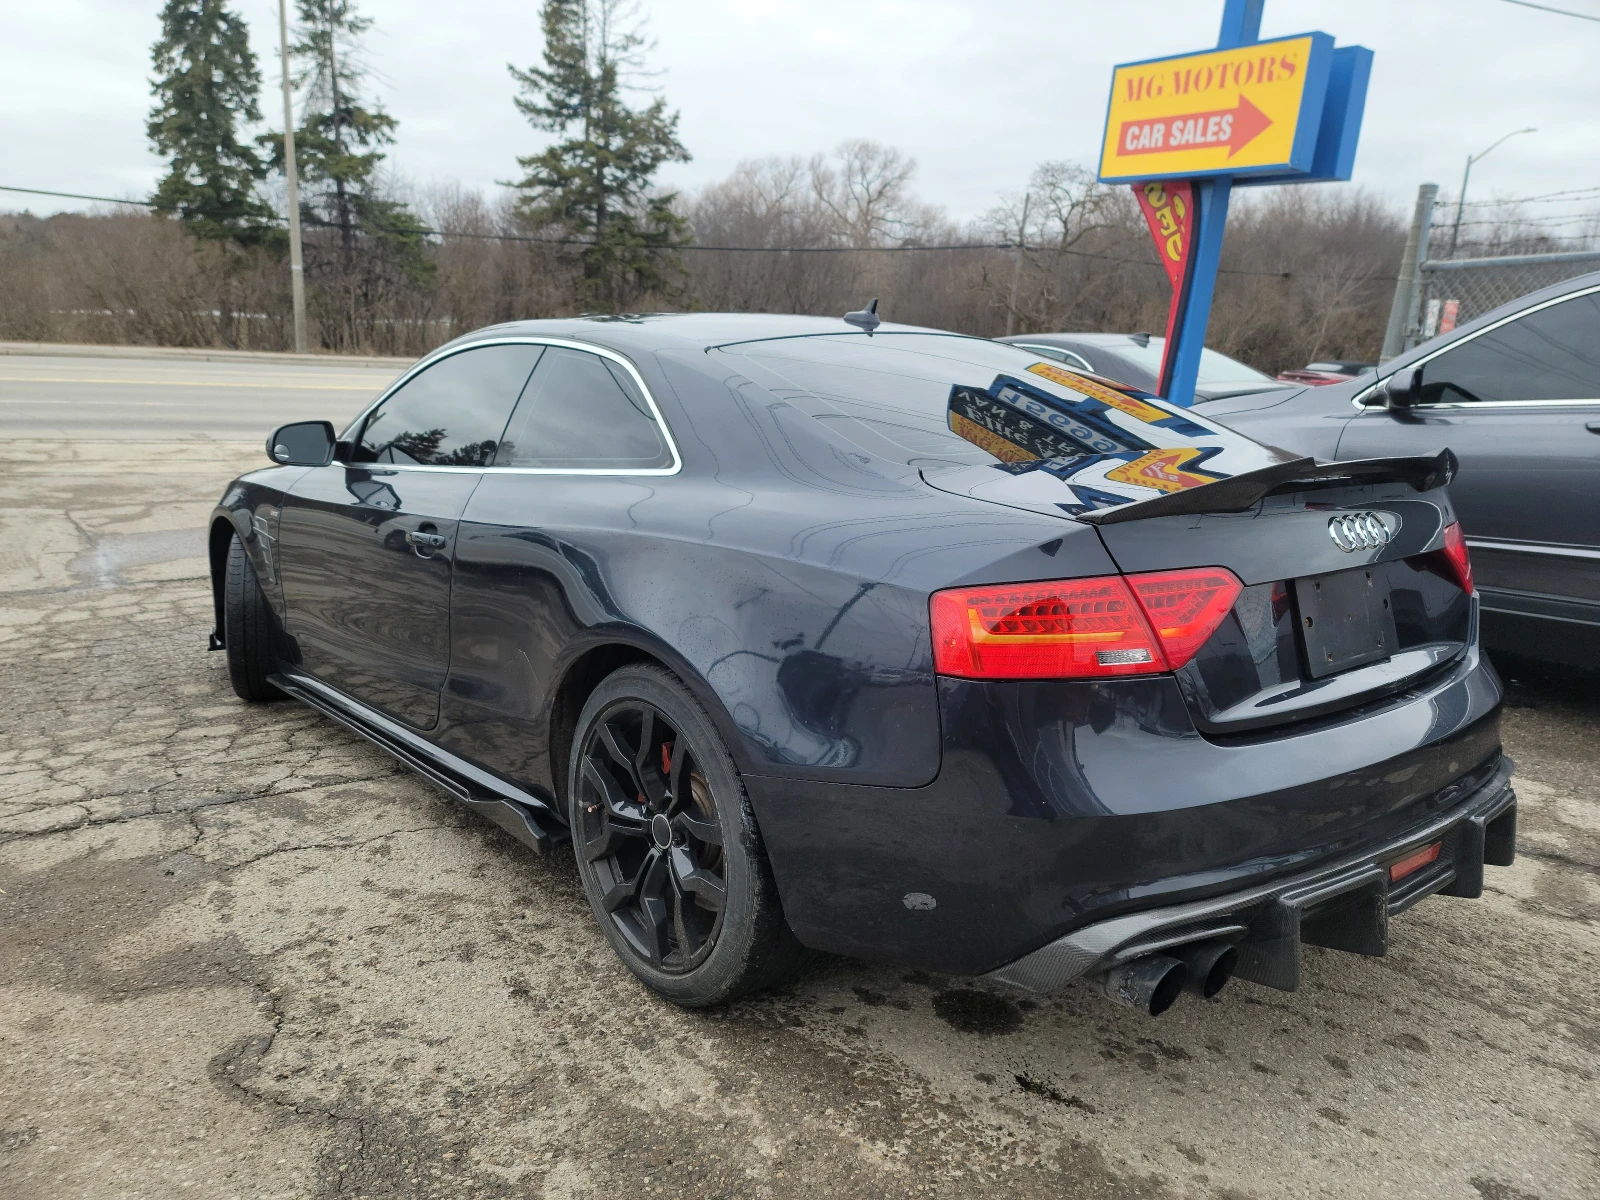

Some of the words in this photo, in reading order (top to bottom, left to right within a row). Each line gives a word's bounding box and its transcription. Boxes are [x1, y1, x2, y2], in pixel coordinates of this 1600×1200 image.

[1123, 73, 1164, 103] MG
[1169, 52, 1299, 96] MOTORS
[1125, 123, 1165, 151] CAR
[1169, 114, 1234, 146] SALES
